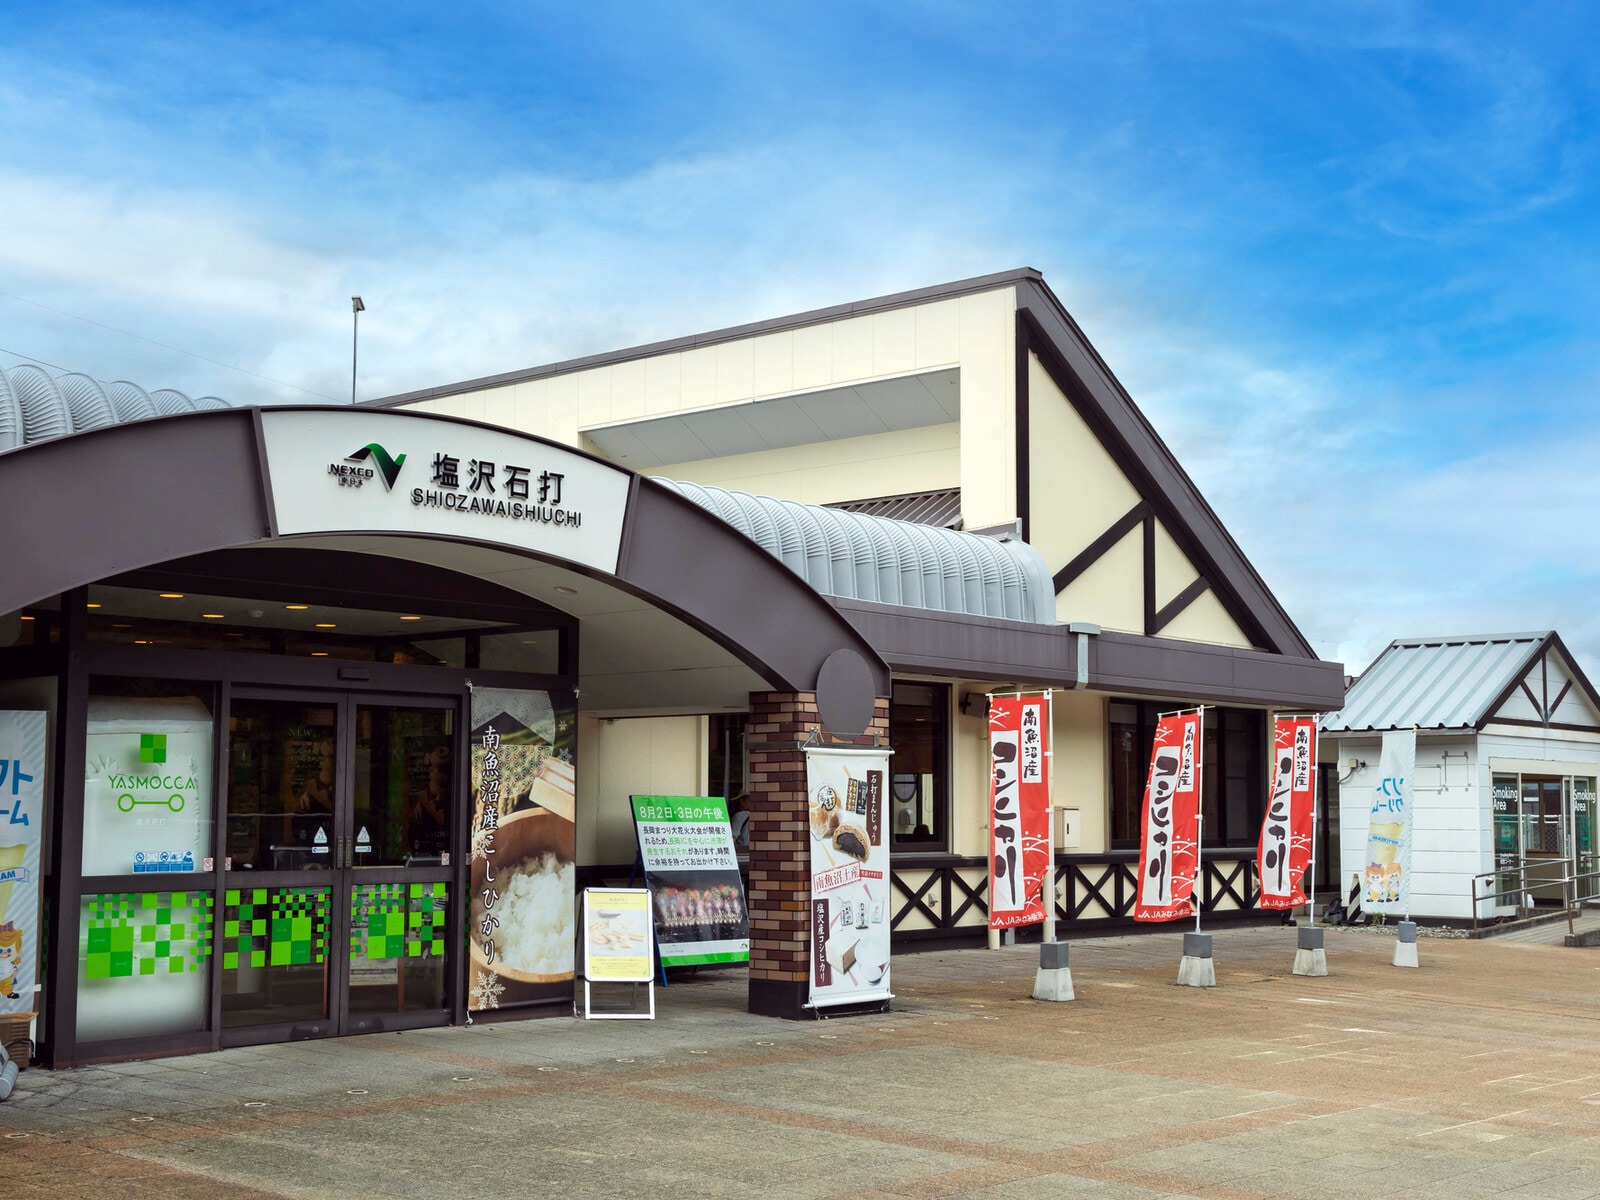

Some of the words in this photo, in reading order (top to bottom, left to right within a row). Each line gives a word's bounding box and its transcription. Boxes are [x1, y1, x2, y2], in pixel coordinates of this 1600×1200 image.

[329, 463, 374, 479] NEXCO
[339, 476, 364, 487] 東日本
[433, 452, 565, 504] 塩沢石打
[411, 487, 582, 527] SHIOZAWAISHIUCHI
[1023, 708, 1040, 779] 南魚沼産
[1178, 725, 1194, 789] 南魚沼産
[1295, 729, 1309, 788] 南魚沼産
[108, 775, 195, 790] YASMOCCA
[870, 774, 879, 843] 石打まんじゅう
[1492, 785, 1518, 802] Smoking
[1493, 799, 1507, 811] Area
[1574, 788, 1596, 804] Smoking
[1574, 802, 1586, 812] Area
[481, 725, 500, 965] 南魚沼産こしひかり
[992, 741, 1017, 906] コシヒカリ
[1149, 756, 1179, 902] コシヒカリ
[1265, 757, 1291, 892] コシヒカリ
[816, 903, 826, 983] 塩沢産コシヒカリ
